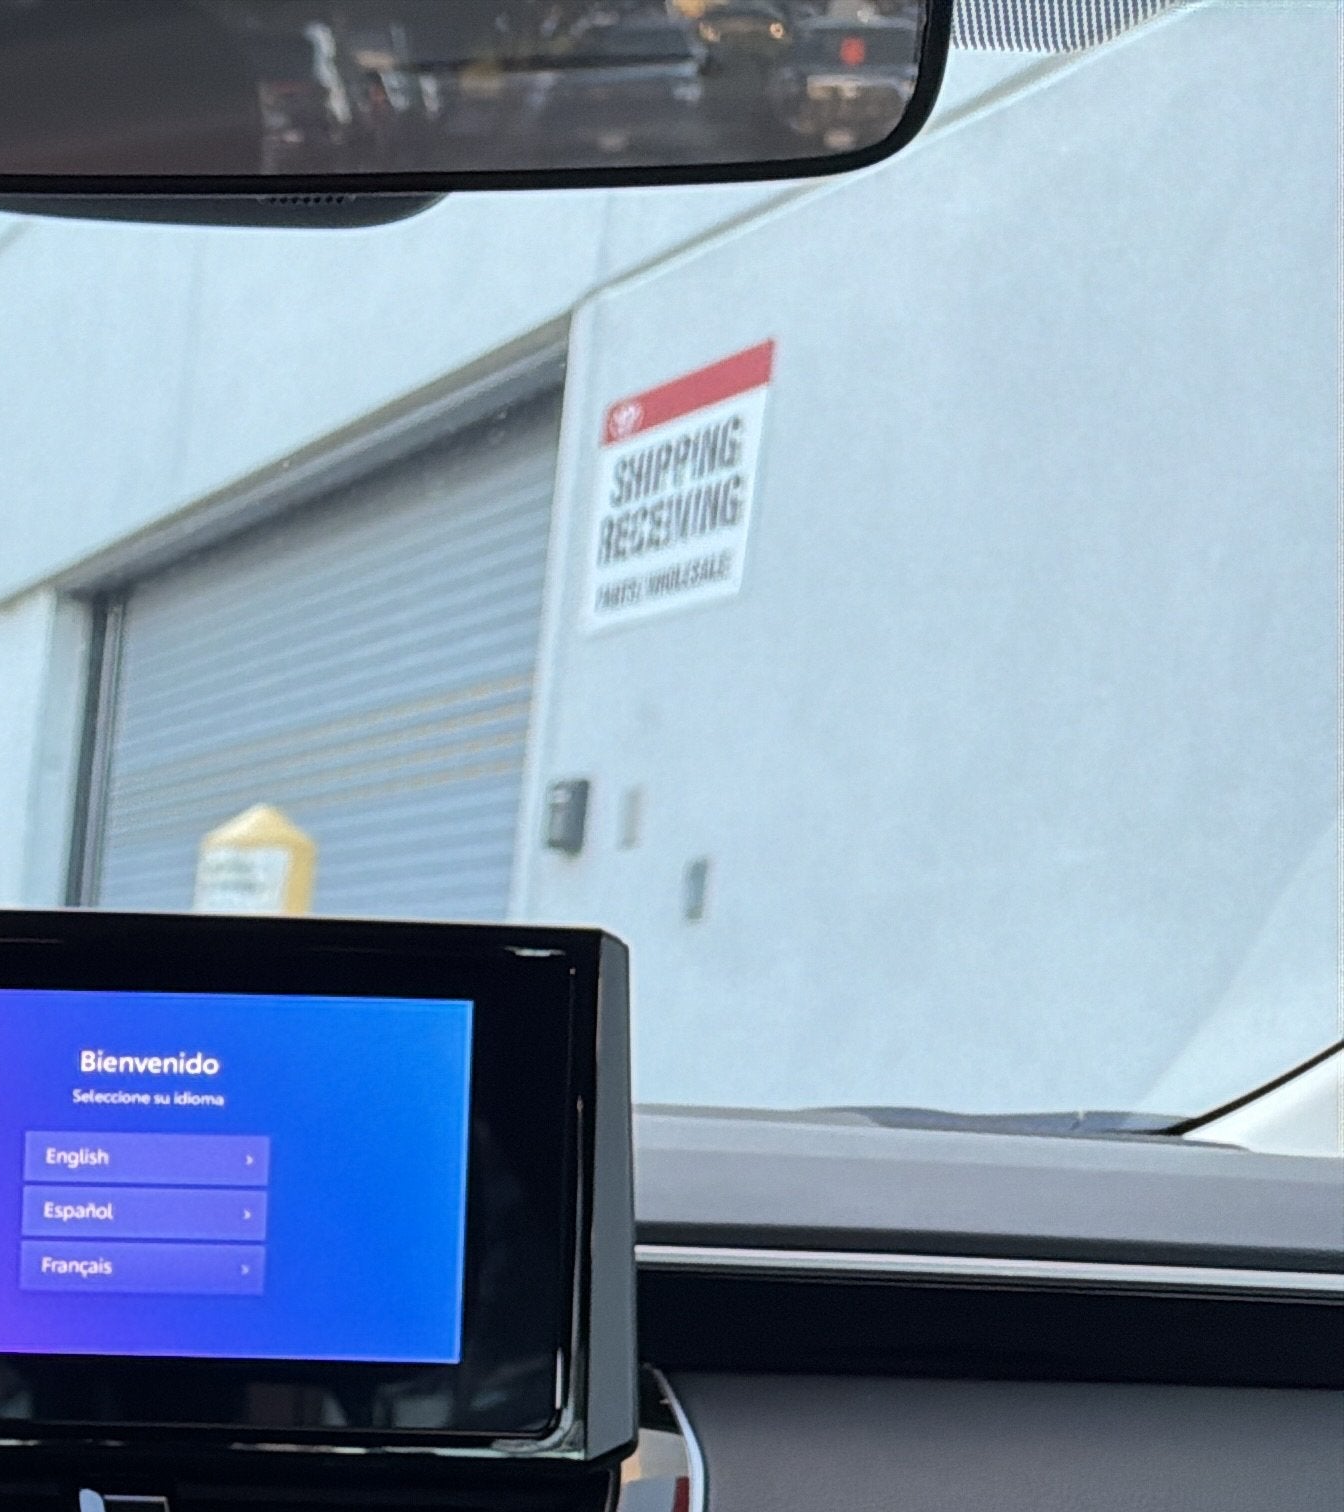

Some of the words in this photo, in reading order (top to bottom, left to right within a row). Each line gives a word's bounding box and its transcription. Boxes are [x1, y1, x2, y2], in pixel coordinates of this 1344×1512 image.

[610, 416, 743, 508] SHIPPING
[597, 475, 743, 569] RECEIVING
[80, 1050, 220, 1075] Bienvenido
[72, 1088, 151, 1105] Seleccione
[153, 1094, 170, 1105] su
[173, 1091, 224, 1107] idioma
[45, 1147, 109, 1169] English
[43, 1201, 113, 1222] Español
[41, 1257, 112, 1278] Français
